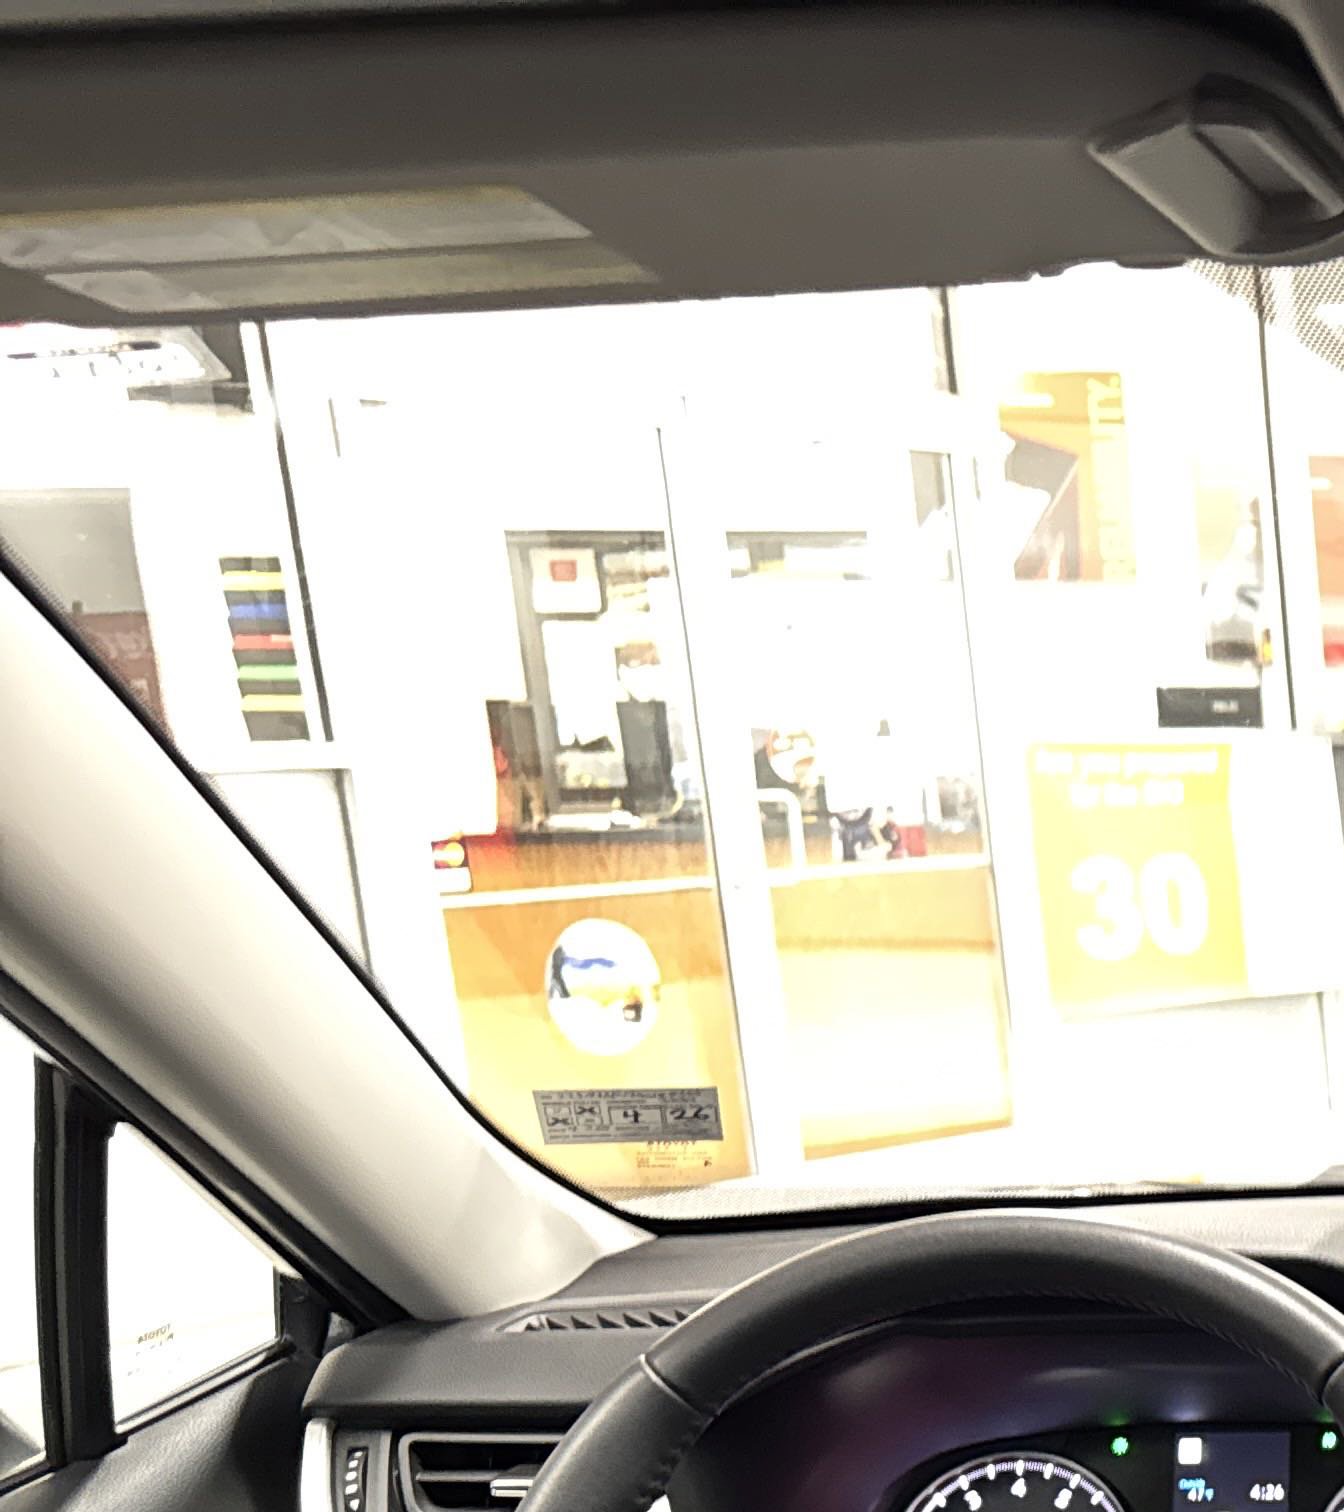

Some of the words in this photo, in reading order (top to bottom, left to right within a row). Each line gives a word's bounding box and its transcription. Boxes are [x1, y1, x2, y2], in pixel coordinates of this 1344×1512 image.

[1071, 852, 1209, 961] 30
[1010, 1477, 1028, 1498] 4
[1249, 1483, 1285, 1501] 4:26
